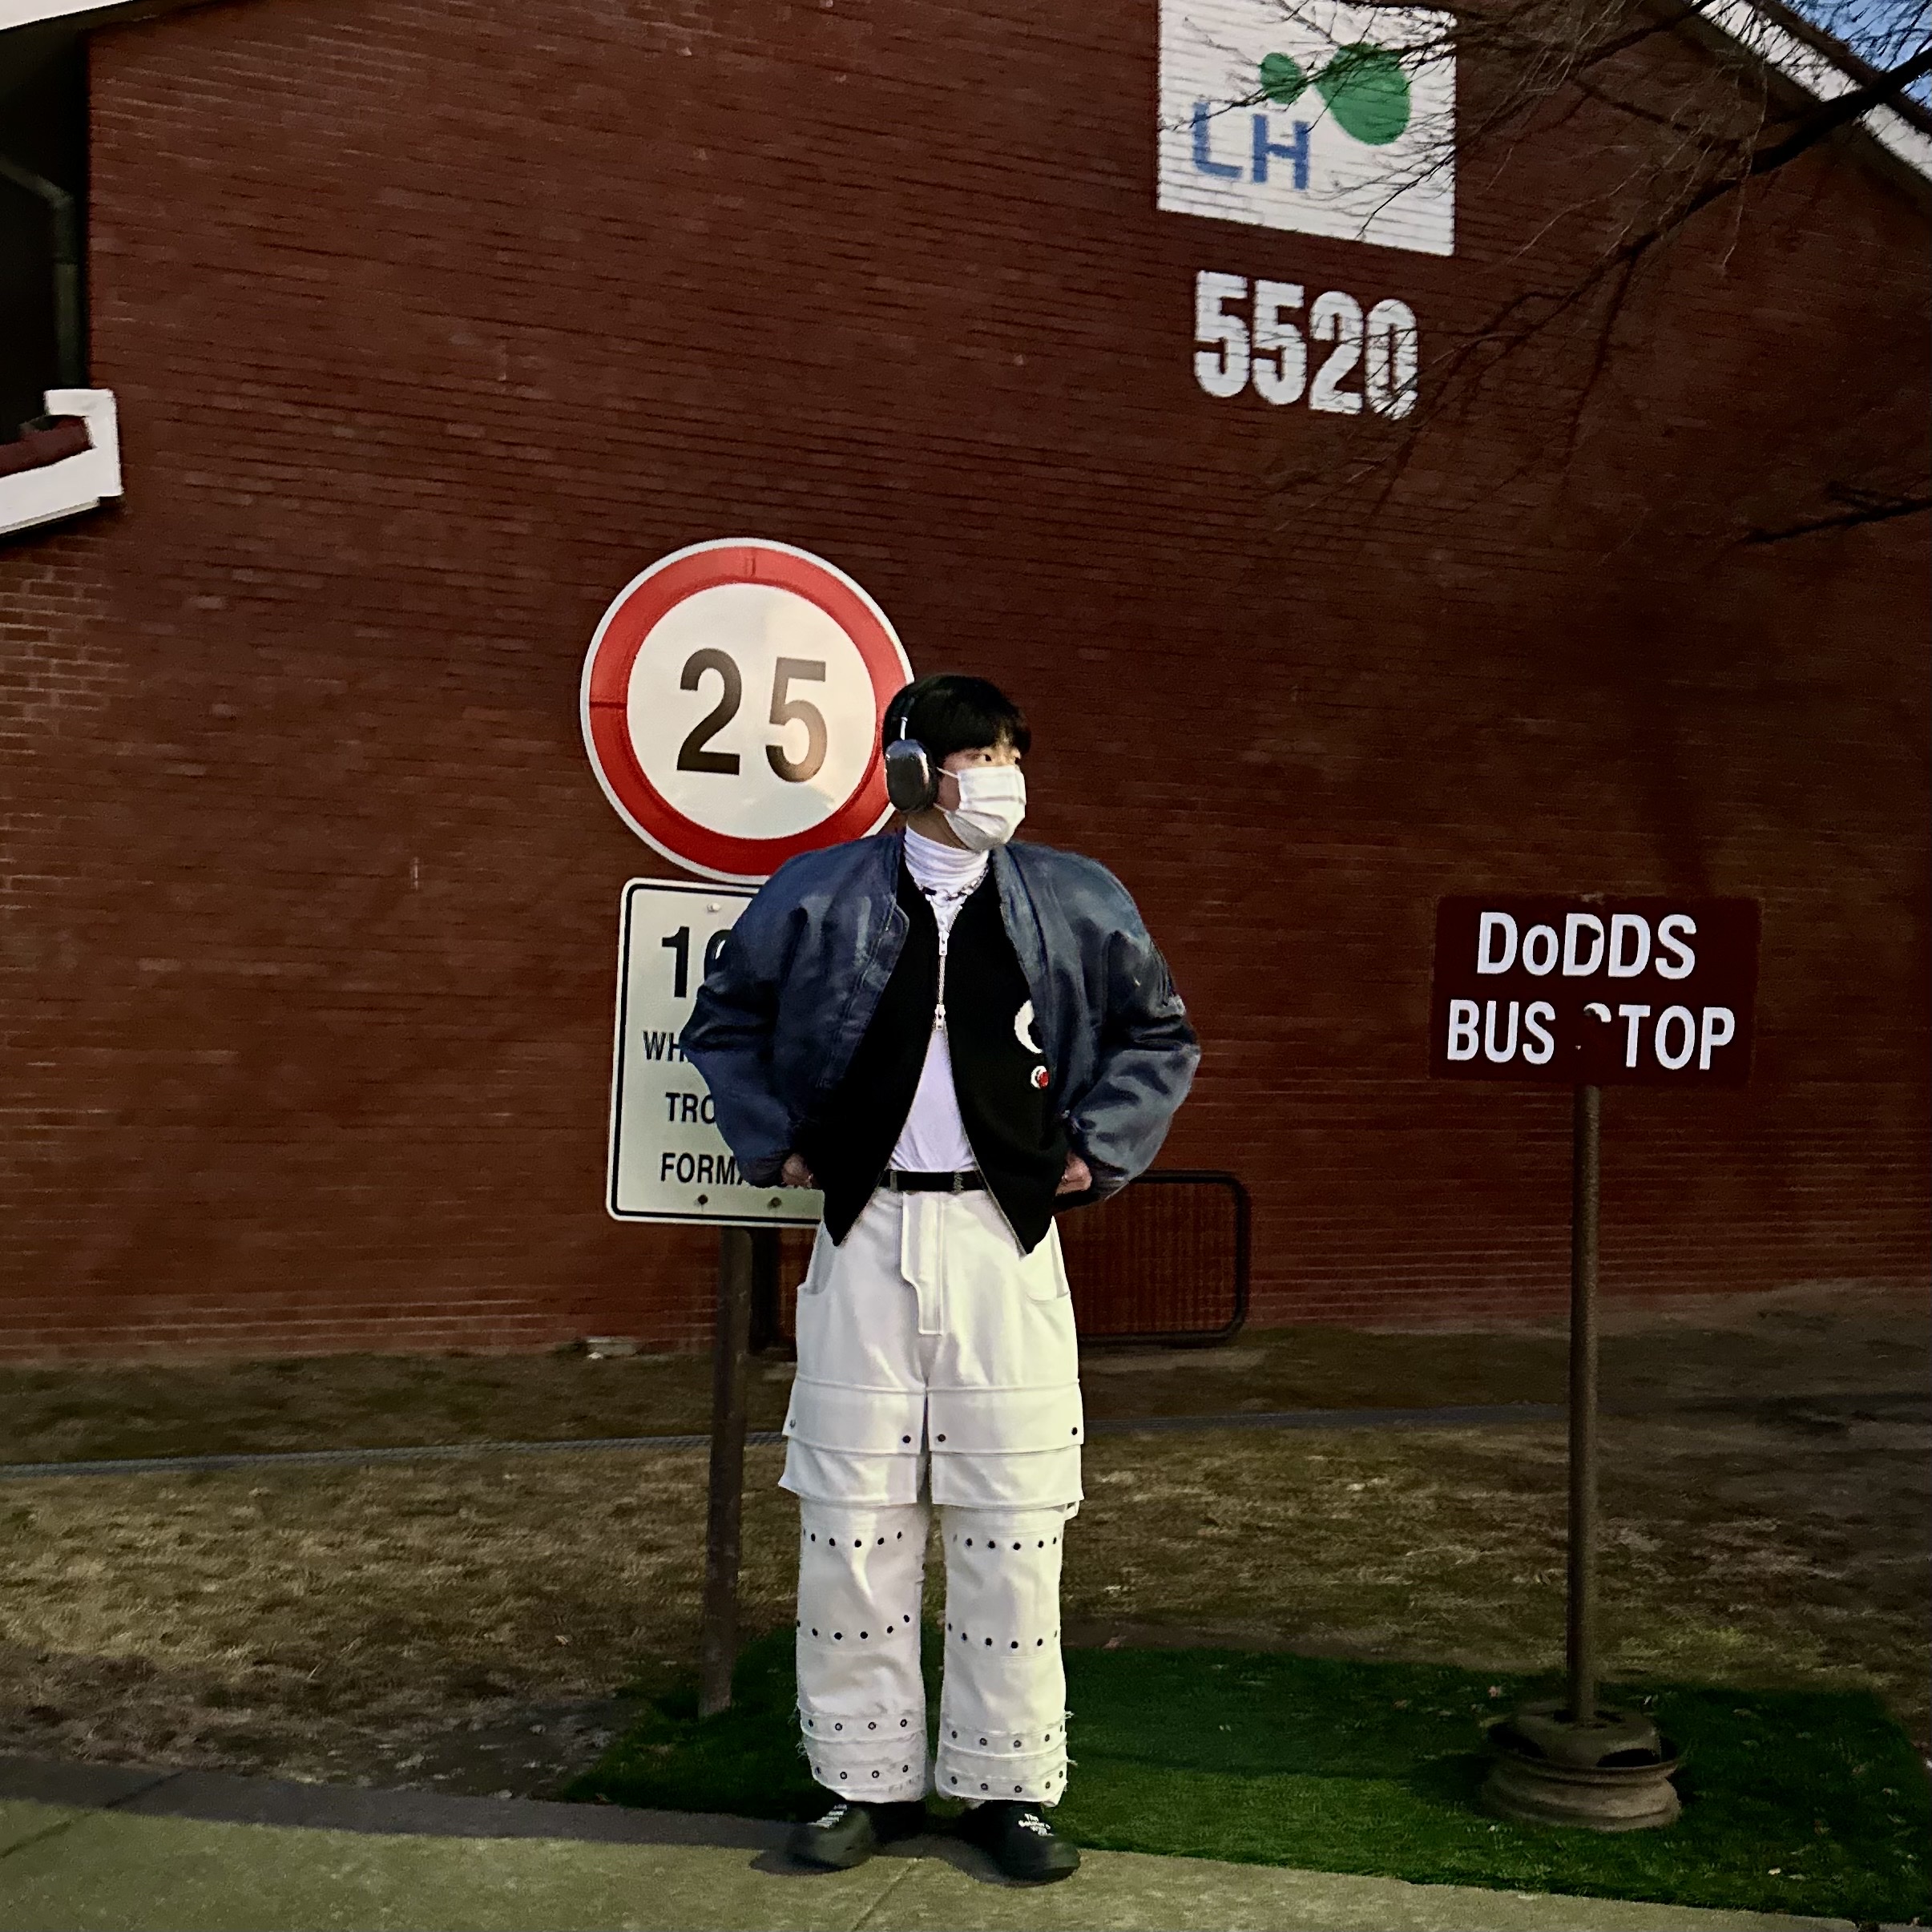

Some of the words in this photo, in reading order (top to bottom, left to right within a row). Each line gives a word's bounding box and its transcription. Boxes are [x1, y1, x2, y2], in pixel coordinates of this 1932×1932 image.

[1192, 102, 1309, 190] LH
[1194, 270, 1418, 421] 5520
[676, 647, 828, 783] 25
[1447, 999, 1555, 1064] BUS
[1583, 1002, 1736, 1071] TOP
[661, 1152, 744, 1185] FORM
